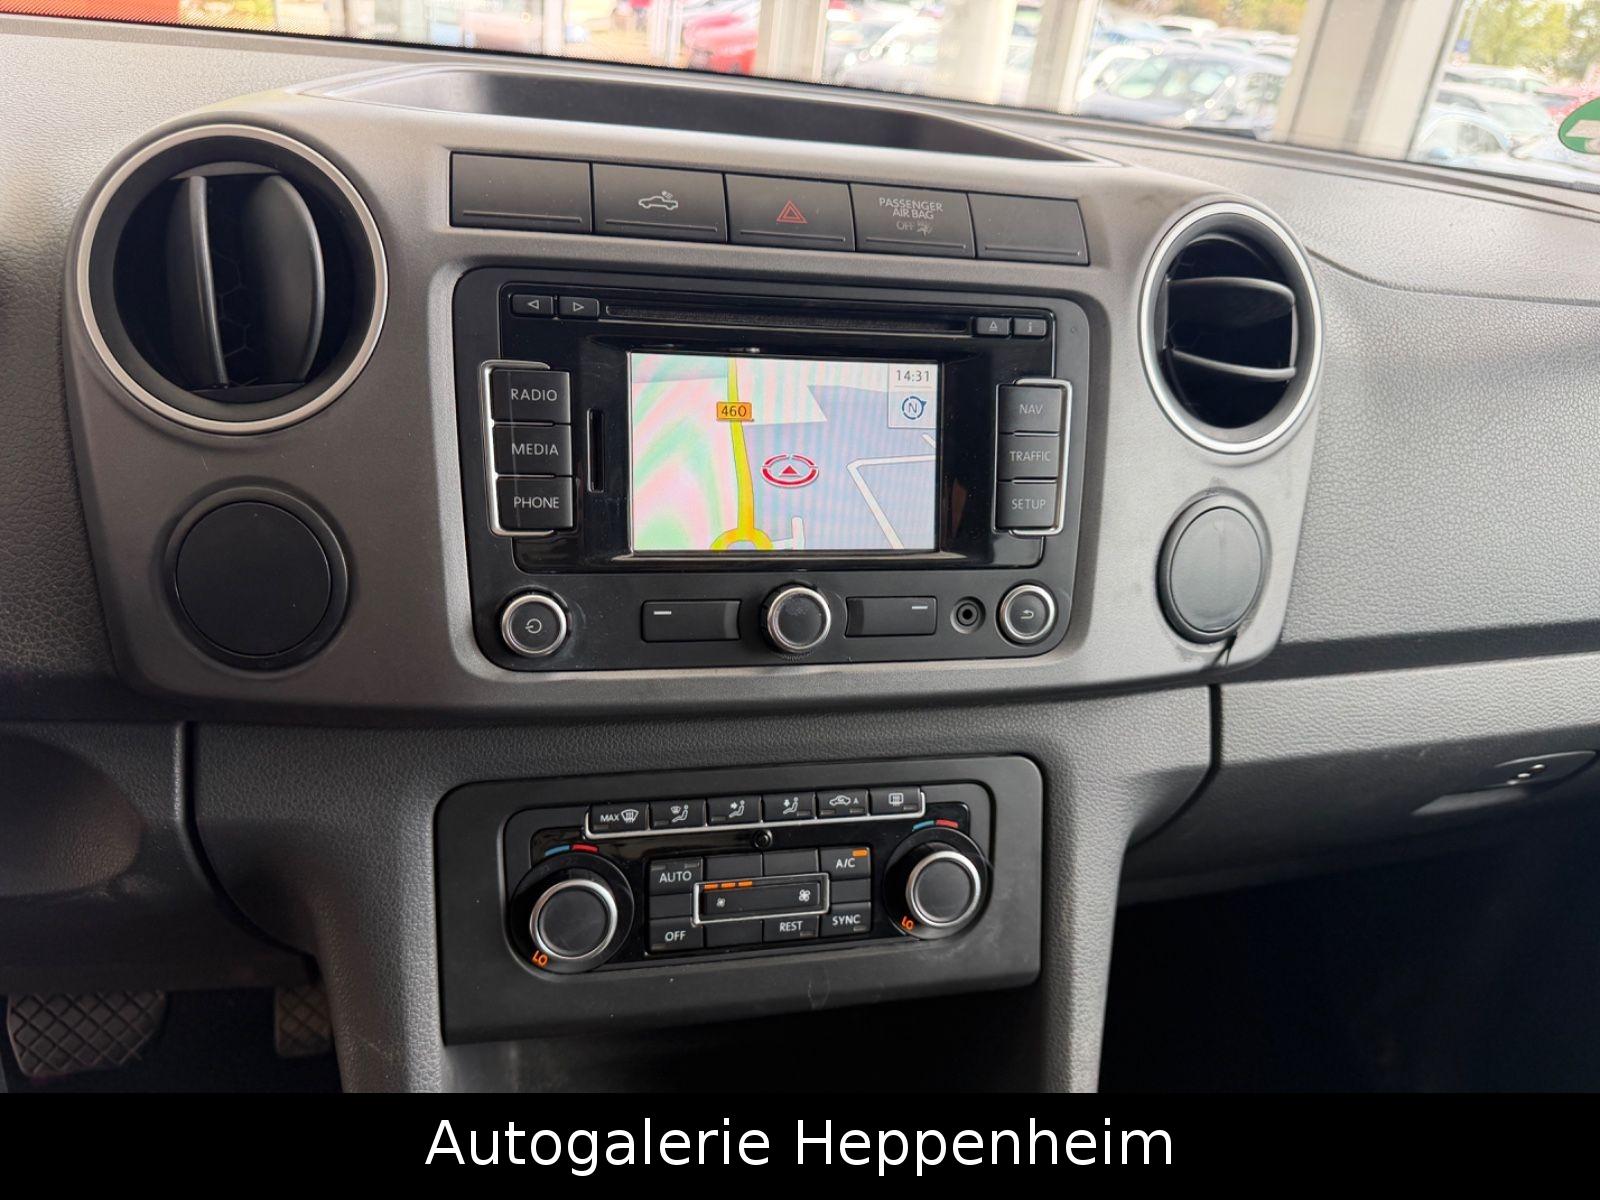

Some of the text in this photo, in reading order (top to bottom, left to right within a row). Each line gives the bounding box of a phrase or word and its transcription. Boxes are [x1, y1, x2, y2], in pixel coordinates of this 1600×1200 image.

[879, 197, 943, 212] PASSENGER
[896, 369, 930, 382] 14:31
[510, 388, 558, 401] RADIO
[720, 404, 747, 418] 460
[1019, 403, 1043, 415] NAV
[511, 442, 559, 456] MEDIA
[1009, 450, 1051, 462] TRAFFIC
[513, 496, 560, 510] PHONE
[1011, 499, 1047, 511] SETUP
[600, 812, 620, 823] MAX
[835, 858, 856, 869] A/C
[659, 870, 693, 884] AUTO
[779, 921, 803, 933] REST
[832, 914, 861, 927] SYNC
[901, 915, 915, 932] LO
[664, 930, 687, 943] OFF
[531, 949, 549, 968] LO
